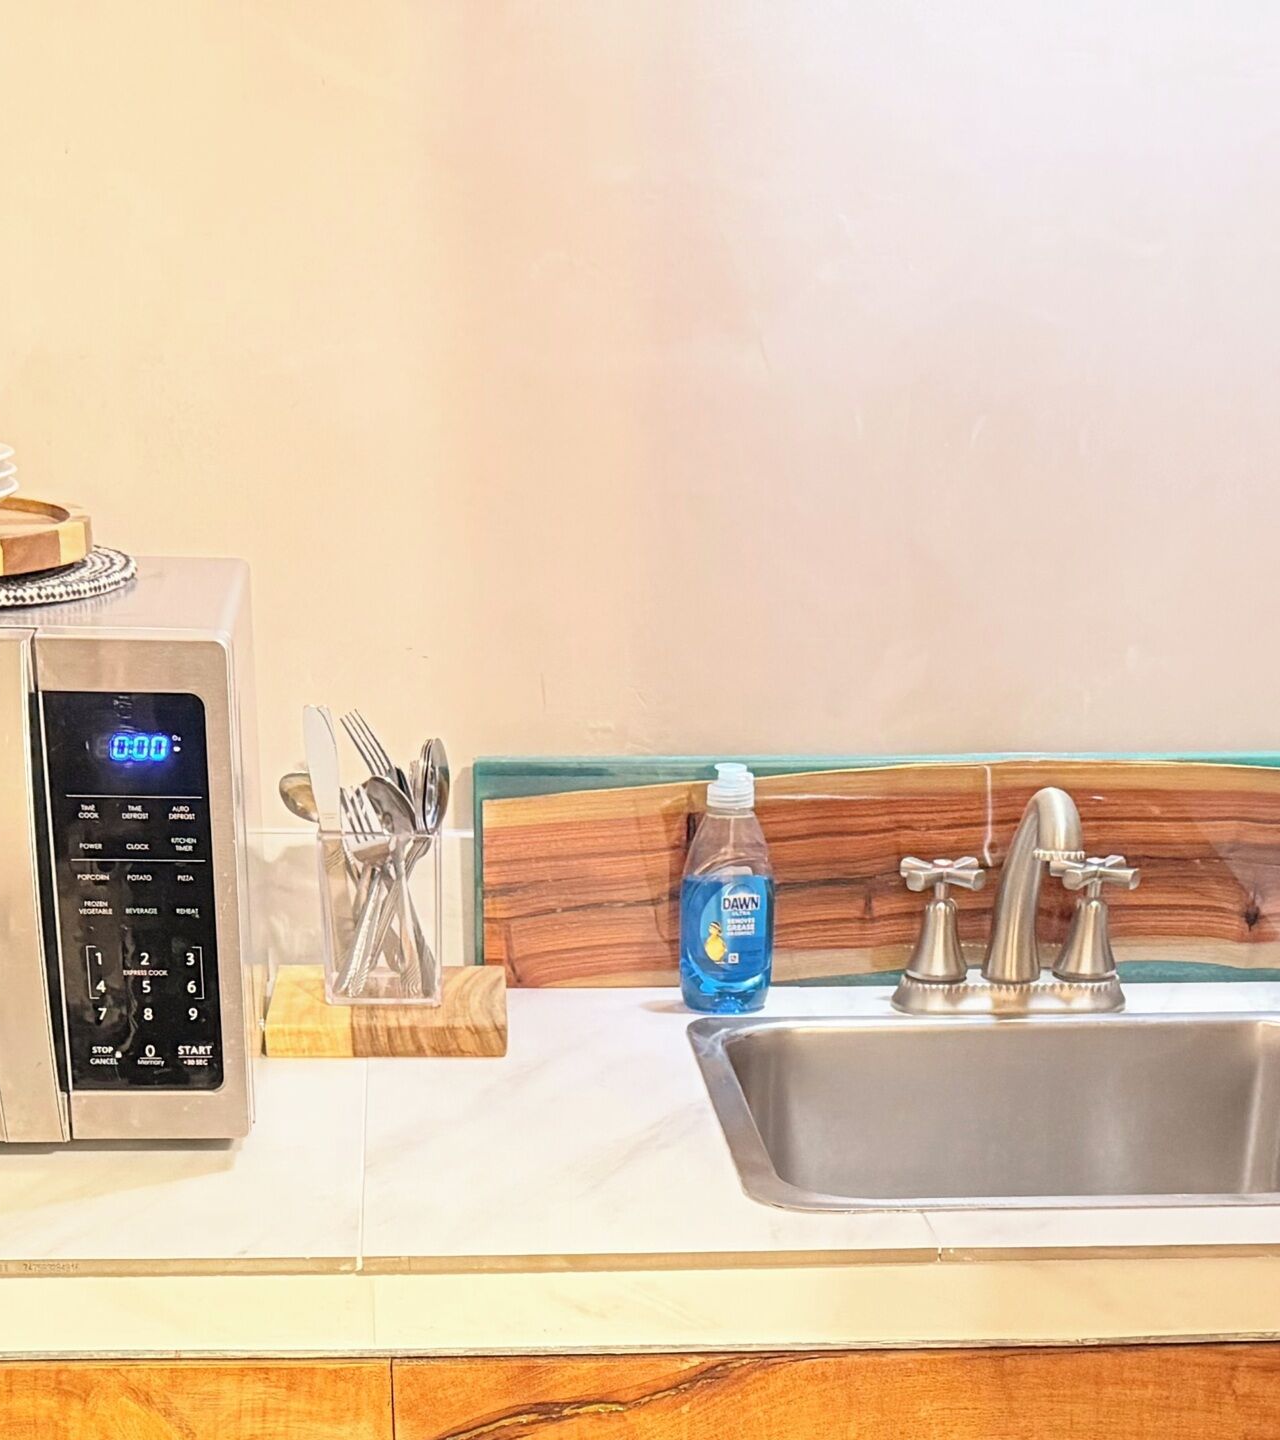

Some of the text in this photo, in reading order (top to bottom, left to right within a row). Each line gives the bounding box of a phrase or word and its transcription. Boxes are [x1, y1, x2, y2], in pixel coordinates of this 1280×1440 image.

[112, 735, 169, 761] 0:00
[723, 896, 759, 910] DAWN
[95, 952, 102, 965] 1
[140, 952, 150, 965] 2
[185, 953, 195, 966] 3
[95, 980, 107, 993] 4
[142, 980, 151, 993] 5
[187, 980, 197, 993] 6
[97, 1007, 107, 1020] 7
[143, 1007, 153, 1021] 8
[188, 1008, 198, 1020] 9
[92, 1046, 114, 1054] STOP
[145, 1044, 156, 1057] 0
[177, 1045, 212, 1055] START
[137, 1059, 165, 1067] Memory
